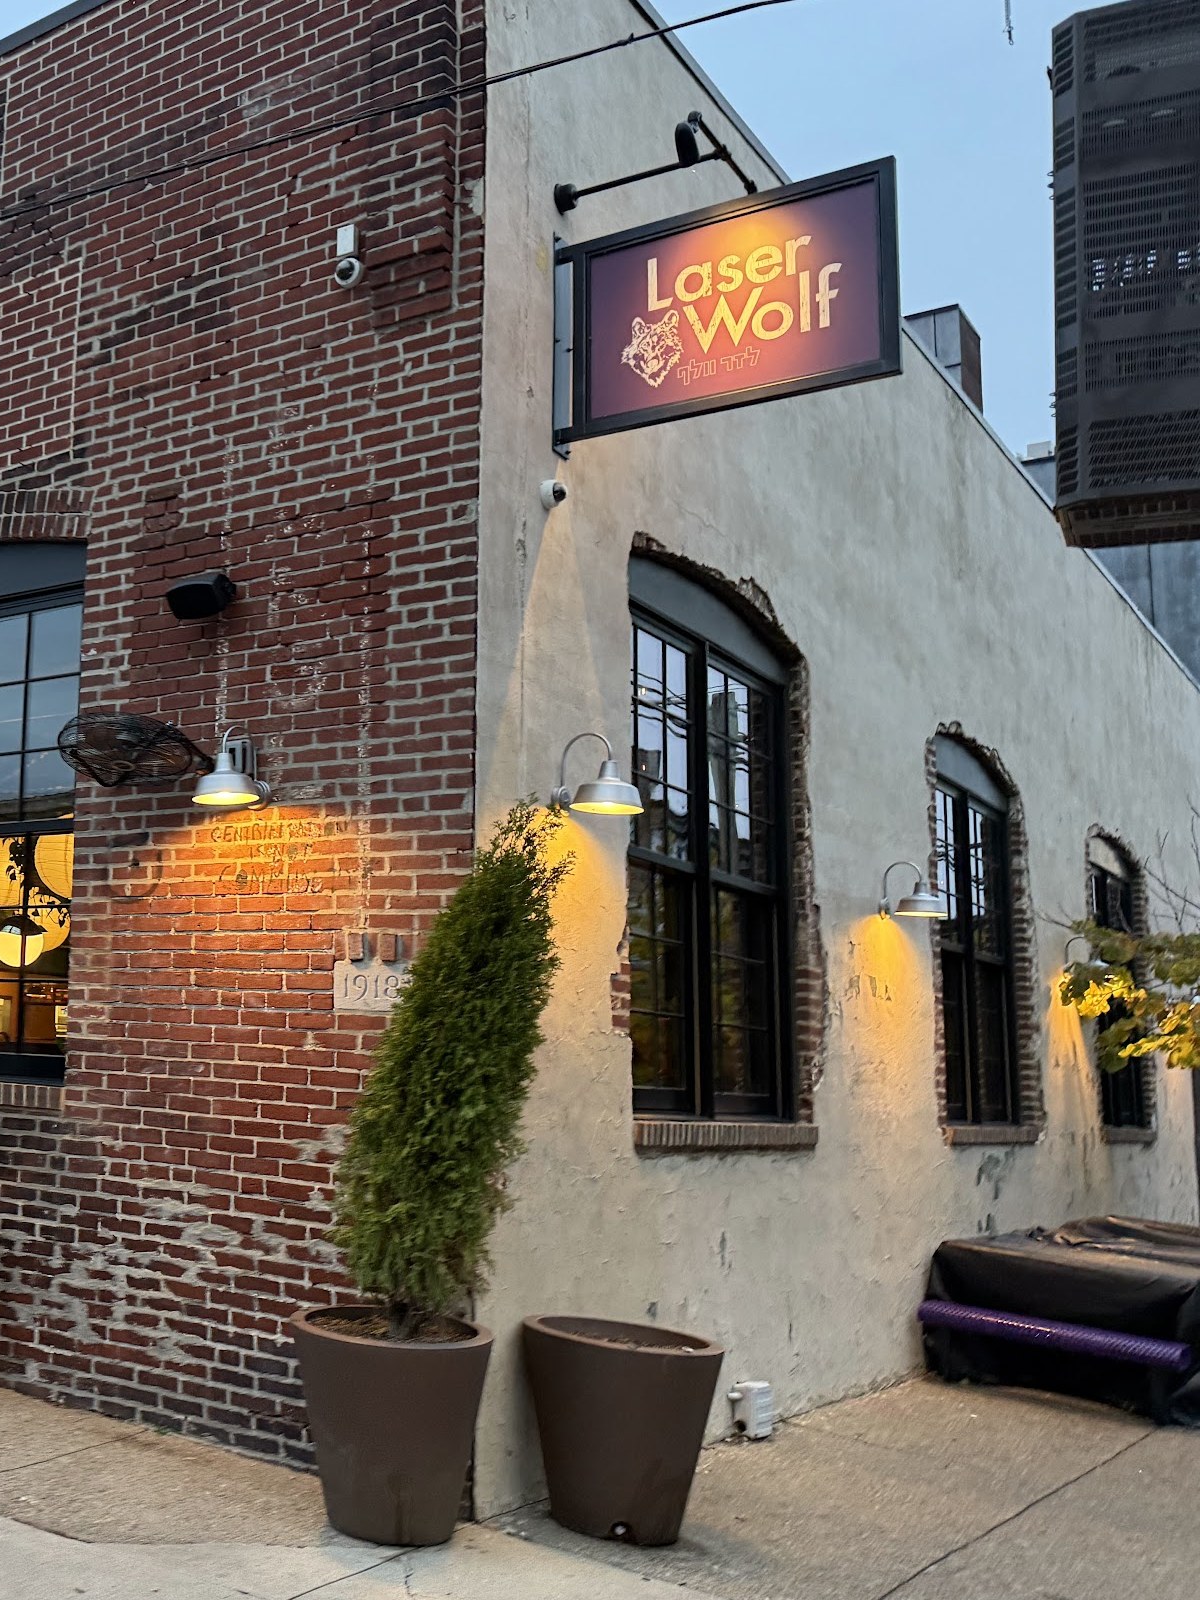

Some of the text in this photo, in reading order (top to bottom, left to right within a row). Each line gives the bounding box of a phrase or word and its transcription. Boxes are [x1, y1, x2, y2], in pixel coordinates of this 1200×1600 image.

[647, 235, 812, 312] Laser
[682, 262, 842, 354] Wolf
[344, 973, 401, 1001] 1918
